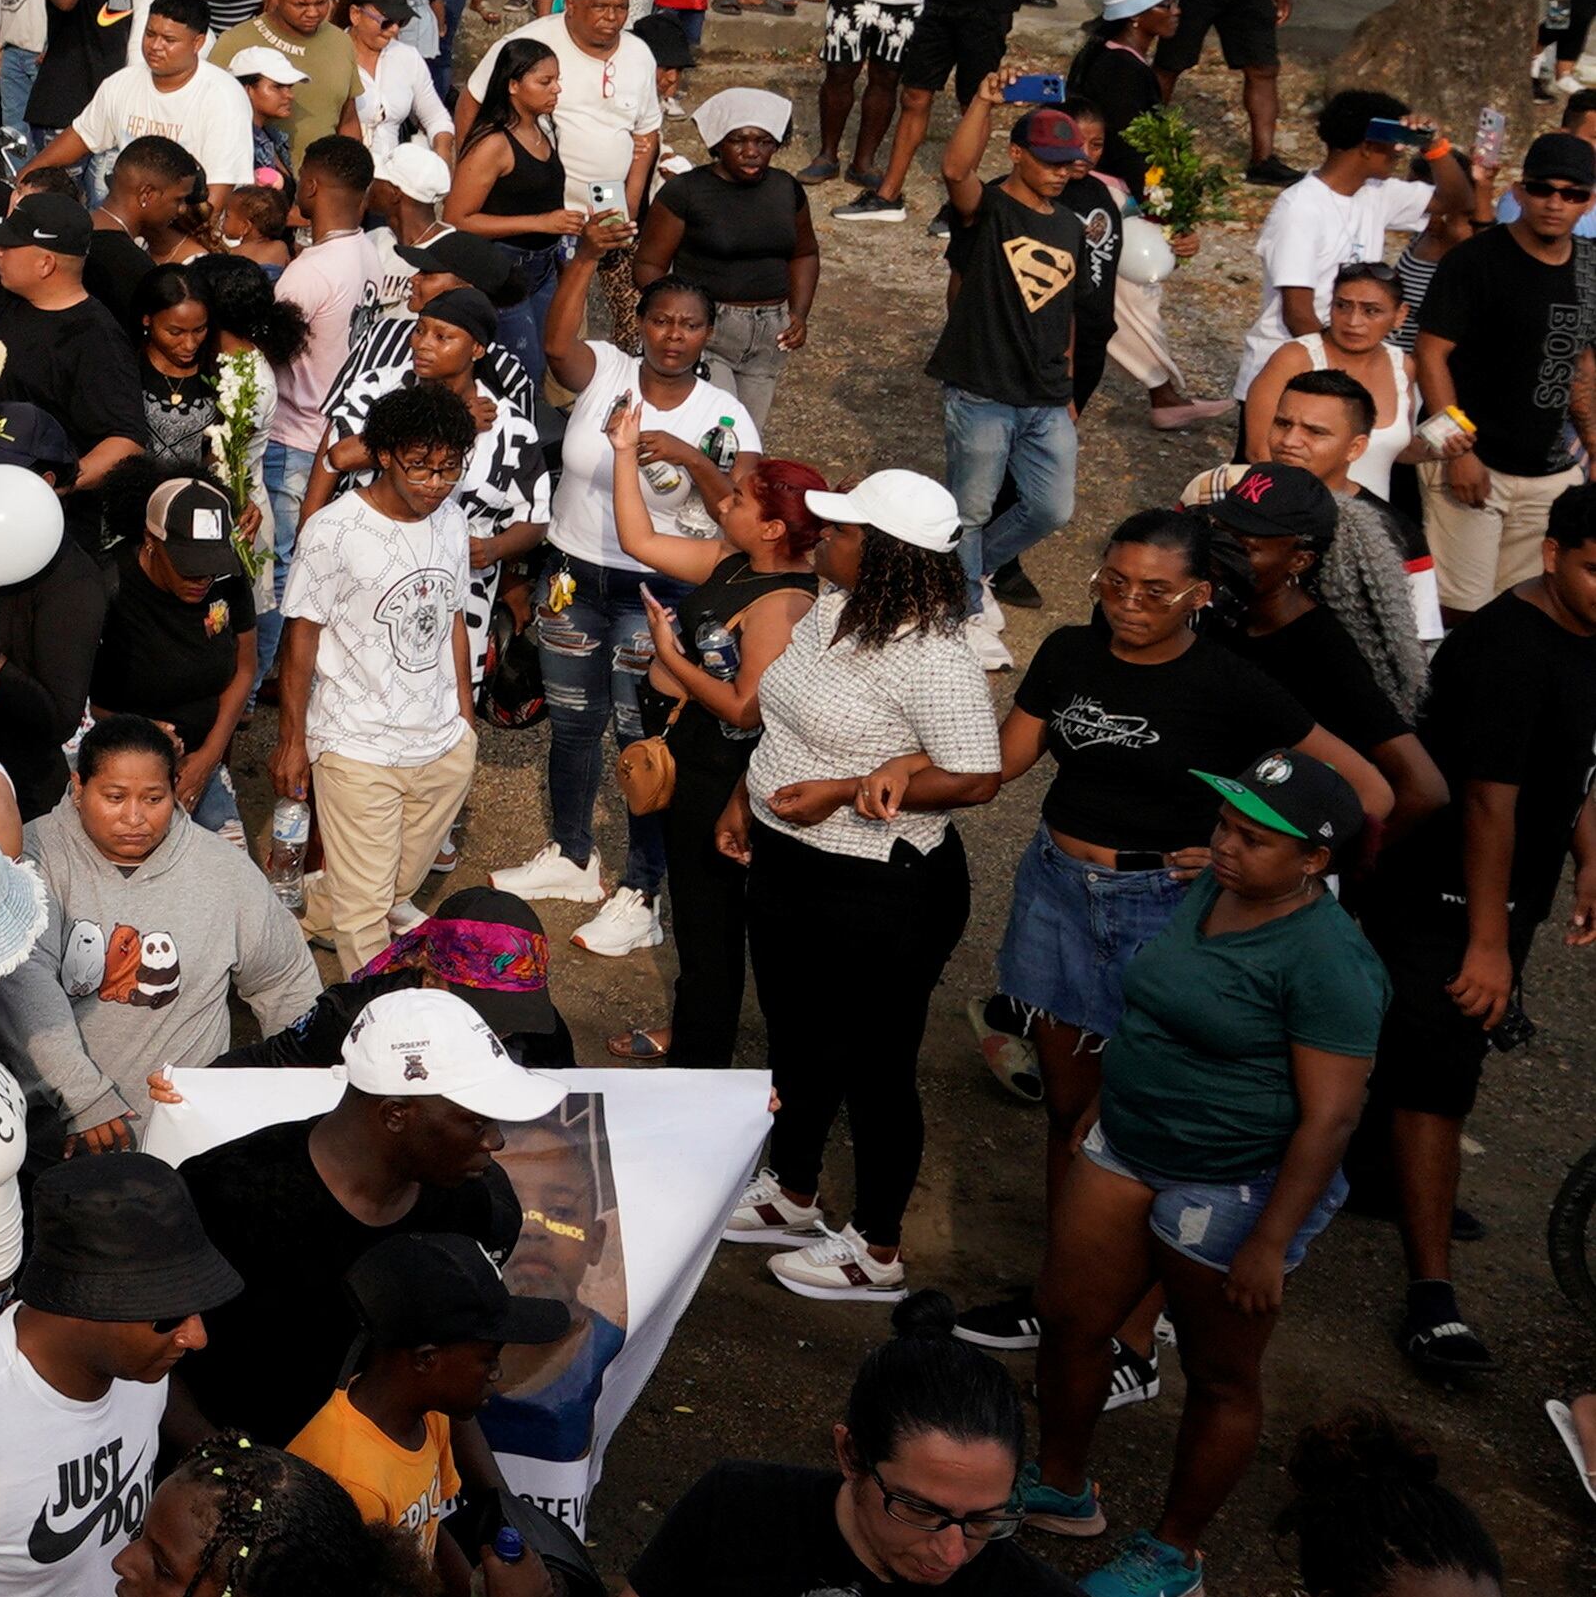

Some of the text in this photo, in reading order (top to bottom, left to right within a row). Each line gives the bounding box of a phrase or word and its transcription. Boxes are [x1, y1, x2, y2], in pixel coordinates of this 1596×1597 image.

[251, 18, 306, 57] BURBERRY
[1531, 303, 1575, 408] BOSS
[389, 1040, 430, 1051] BURBERRY
[544, 1218, 585, 1243] MENOS
[53, 1436, 124, 1518] JUST
[100, 1482, 143, 1548] DO
